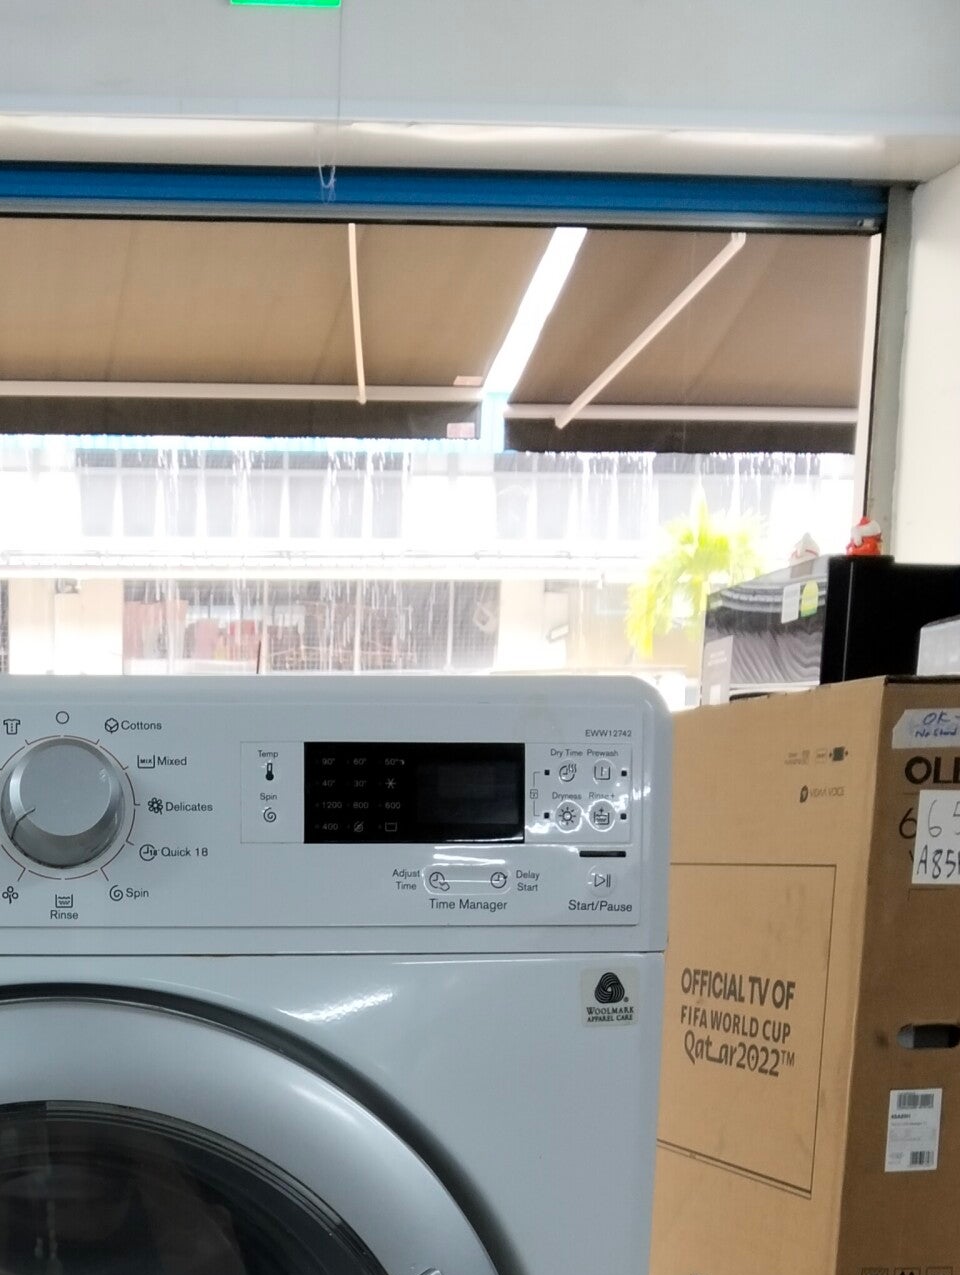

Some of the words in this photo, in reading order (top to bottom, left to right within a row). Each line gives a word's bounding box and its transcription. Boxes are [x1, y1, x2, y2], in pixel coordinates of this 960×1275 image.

[121, 720, 162, 731] Cottons
[585, 729, 632, 738] EWW12742
[258, 750, 278, 759] Temp
[550, 748, 563, 757] Dry
[566, 749, 583, 757] Time
[587, 749, 619, 757] Prewash
[157, 757, 187, 766] Mixed
[259, 793, 277, 802] Spin
[552, 791, 582, 800] Dryness
[166, 802, 213, 812] Delicates
[322, 801, 342, 809] 1200
[161, 847, 191, 857] Quick
[195, 847, 208, 857] 18
[392, 869, 420, 879] Adjust
[515, 870, 539, 881] Delay
[396, 881, 417, 890] Time
[517, 882, 538, 892] Start
[126, 887, 149, 899] Spin
[429, 899, 455, 909] Time
[459, 898, 507, 912] Manager
[568, 899, 633, 912] Start/Pause
[50, 909, 79, 920] Rinse
[681, 967, 745, 1003] OFFICIAL
[749, 975, 770, 1006] TV
[772, 979, 796, 1010] OF
[586, 1006, 634, 1015] WOOLMARK
[681, 1005, 708, 1029] FIFA
[711, 1010, 759, 1038] WORLD
[762, 1019, 791, 1044] CUP
